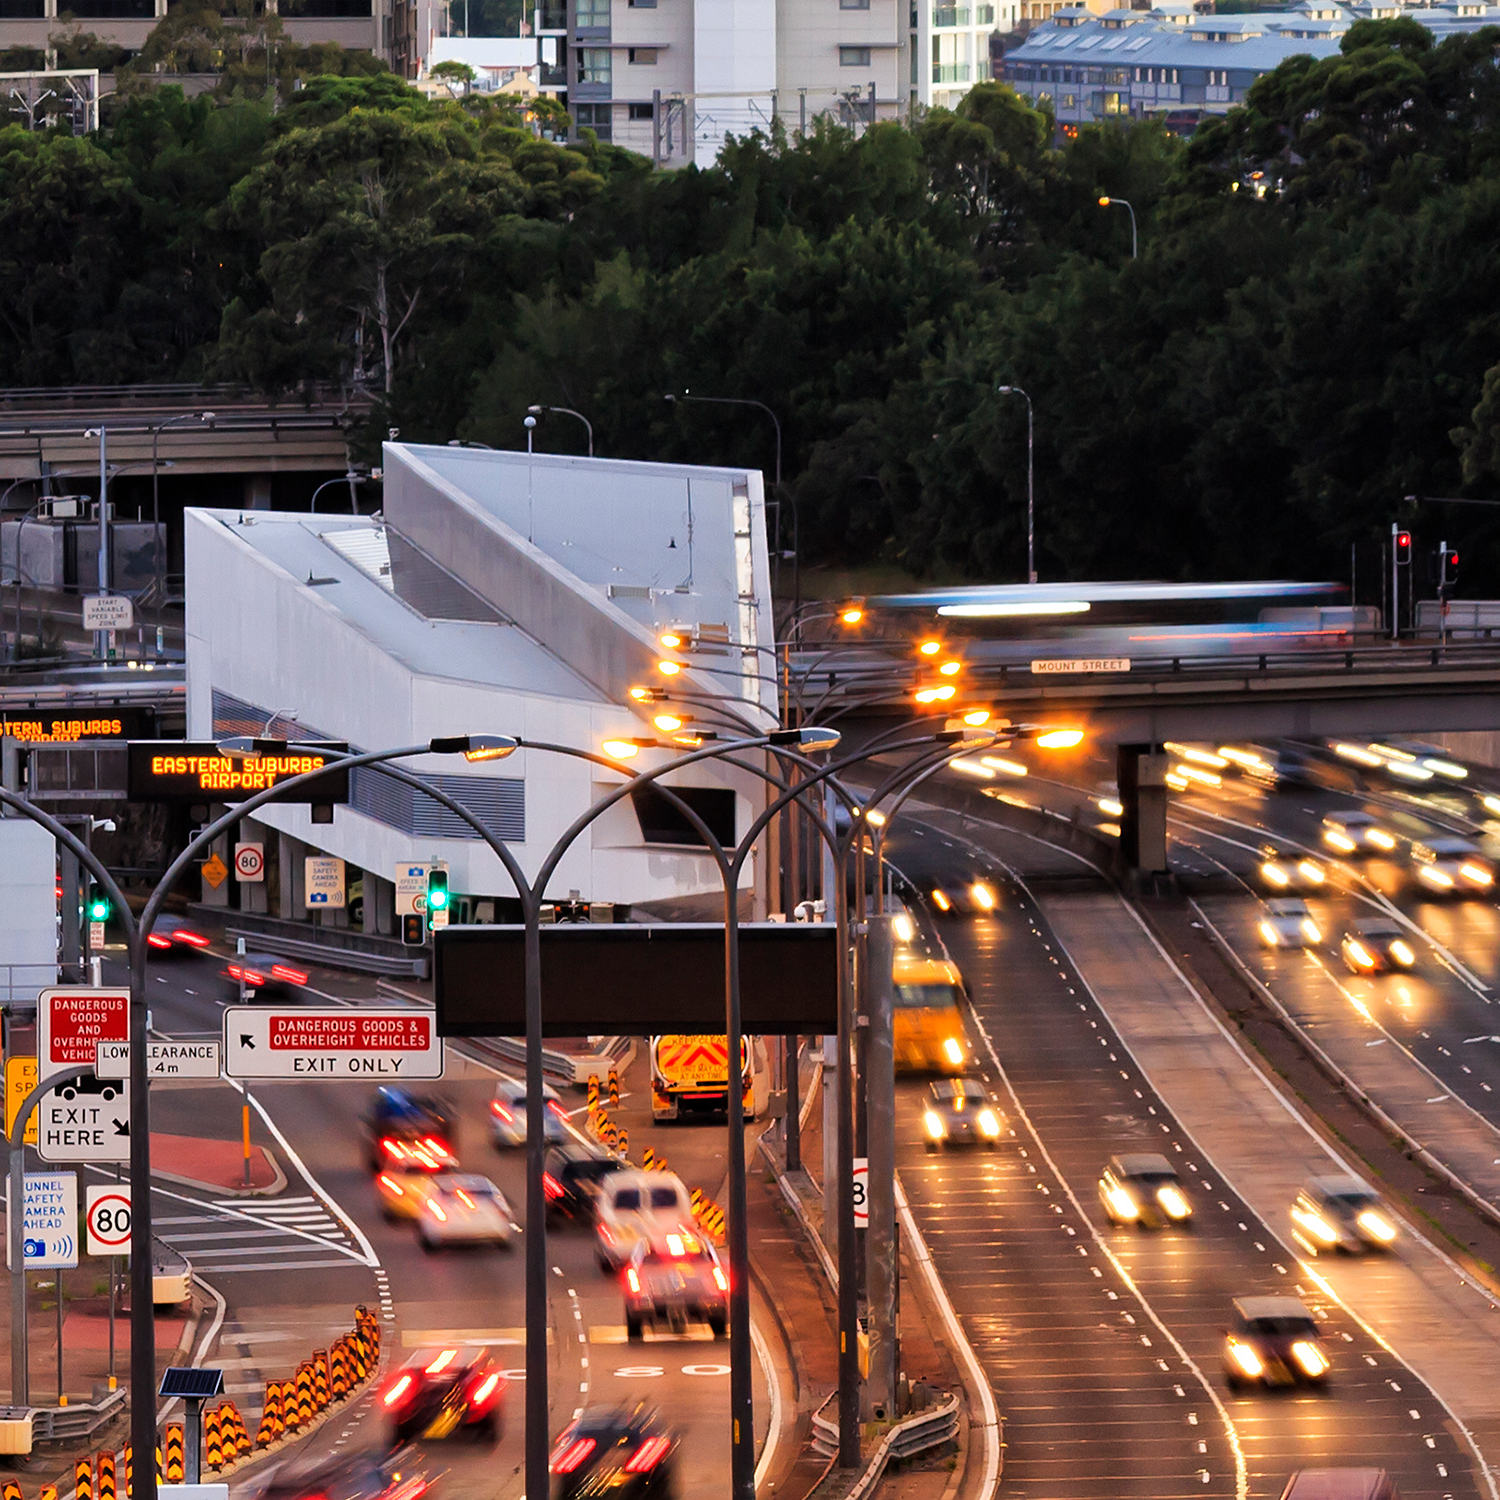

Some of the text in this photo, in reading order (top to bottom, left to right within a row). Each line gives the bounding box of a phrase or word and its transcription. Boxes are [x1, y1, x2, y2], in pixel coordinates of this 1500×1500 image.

[1038, 660, 1123, 671] MOUNT STREET
[51, 719, 122, 735] SUBURBS
[152, 756, 325, 774] EASTERN SUBURBS
[200, 772, 277, 789] AIRPORT
[241, 856, 258, 868] 80
[54, 1000, 124, 1011] DANGEROUS
[70, 1012, 108, 1023] GOODS
[77, 1024, 101, 1035] AND
[278, 1020, 418, 1033] DANGEROUS GOODS &
[273, 1034, 426, 1047] OVERHEIGHT VEHICLES
[61, 1049, 96, 1060] VEHIC
[293, 1058, 404, 1072] EXIT ONLY
[51, 1108, 100, 1124] EXIT
[47, 1130, 105, 1146] HERE
[25, 1181, 65, 1192] UNNEL
[25, 1206, 66, 1216] AMERA
[97, 1209, 131, 1233] 80
[613, 1364, 732, 1378] 80
